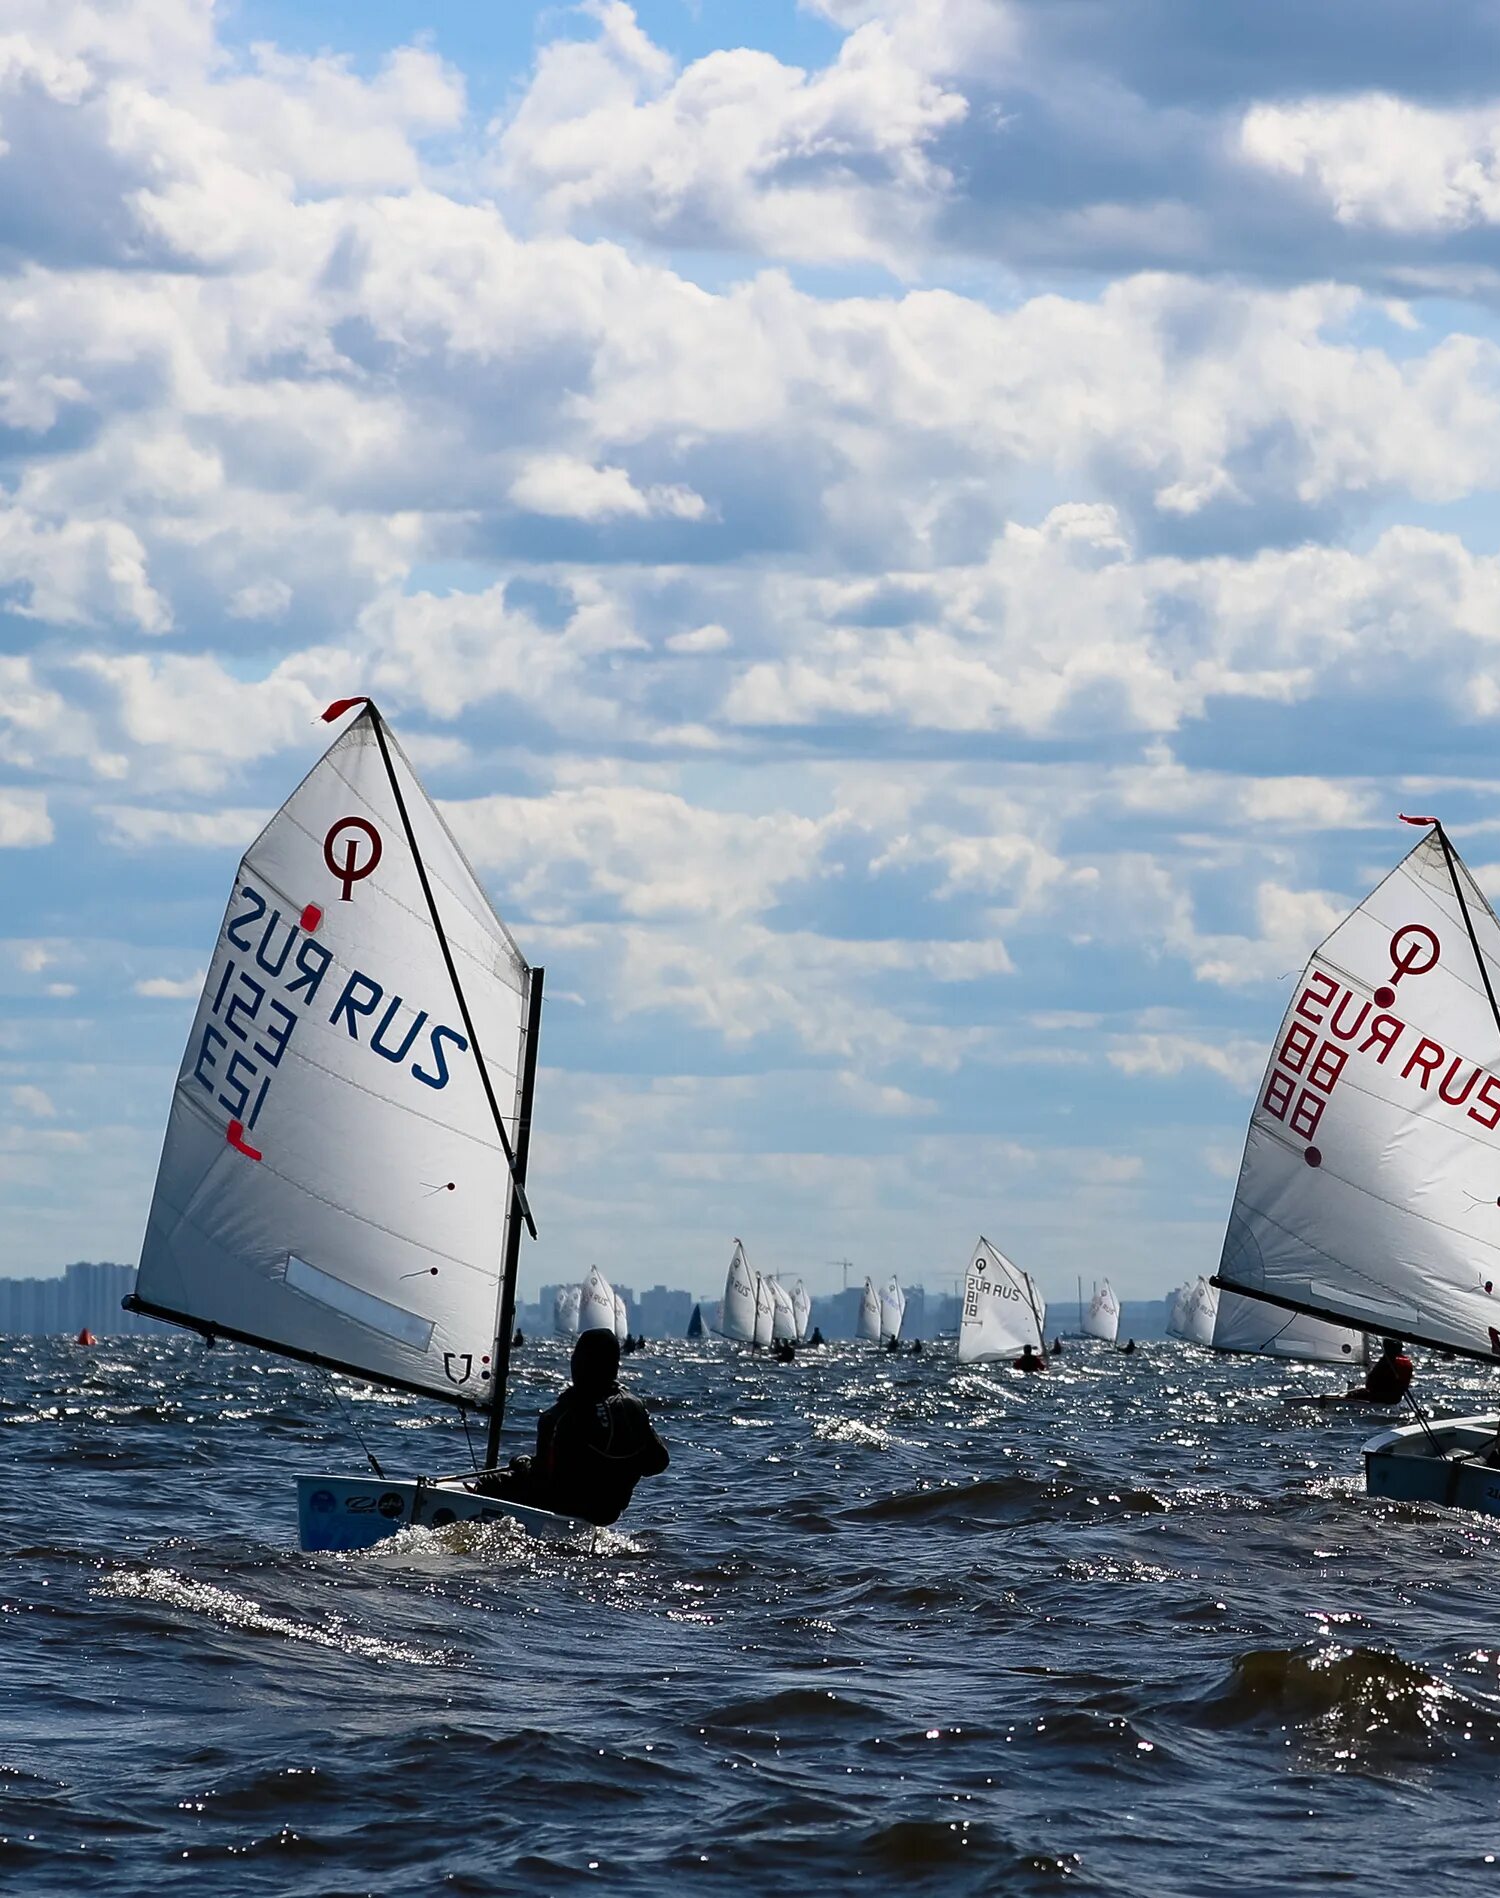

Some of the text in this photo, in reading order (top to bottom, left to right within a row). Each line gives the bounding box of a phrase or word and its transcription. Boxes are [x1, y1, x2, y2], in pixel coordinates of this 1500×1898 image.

[212, 960, 298, 1068] 123
[329, 970, 469, 1090] RUS
[1278, 1020, 1349, 1095] 88
[1262, 1068, 1327, 1142] 88
[993, 1285, 1020, 1301] RUS
